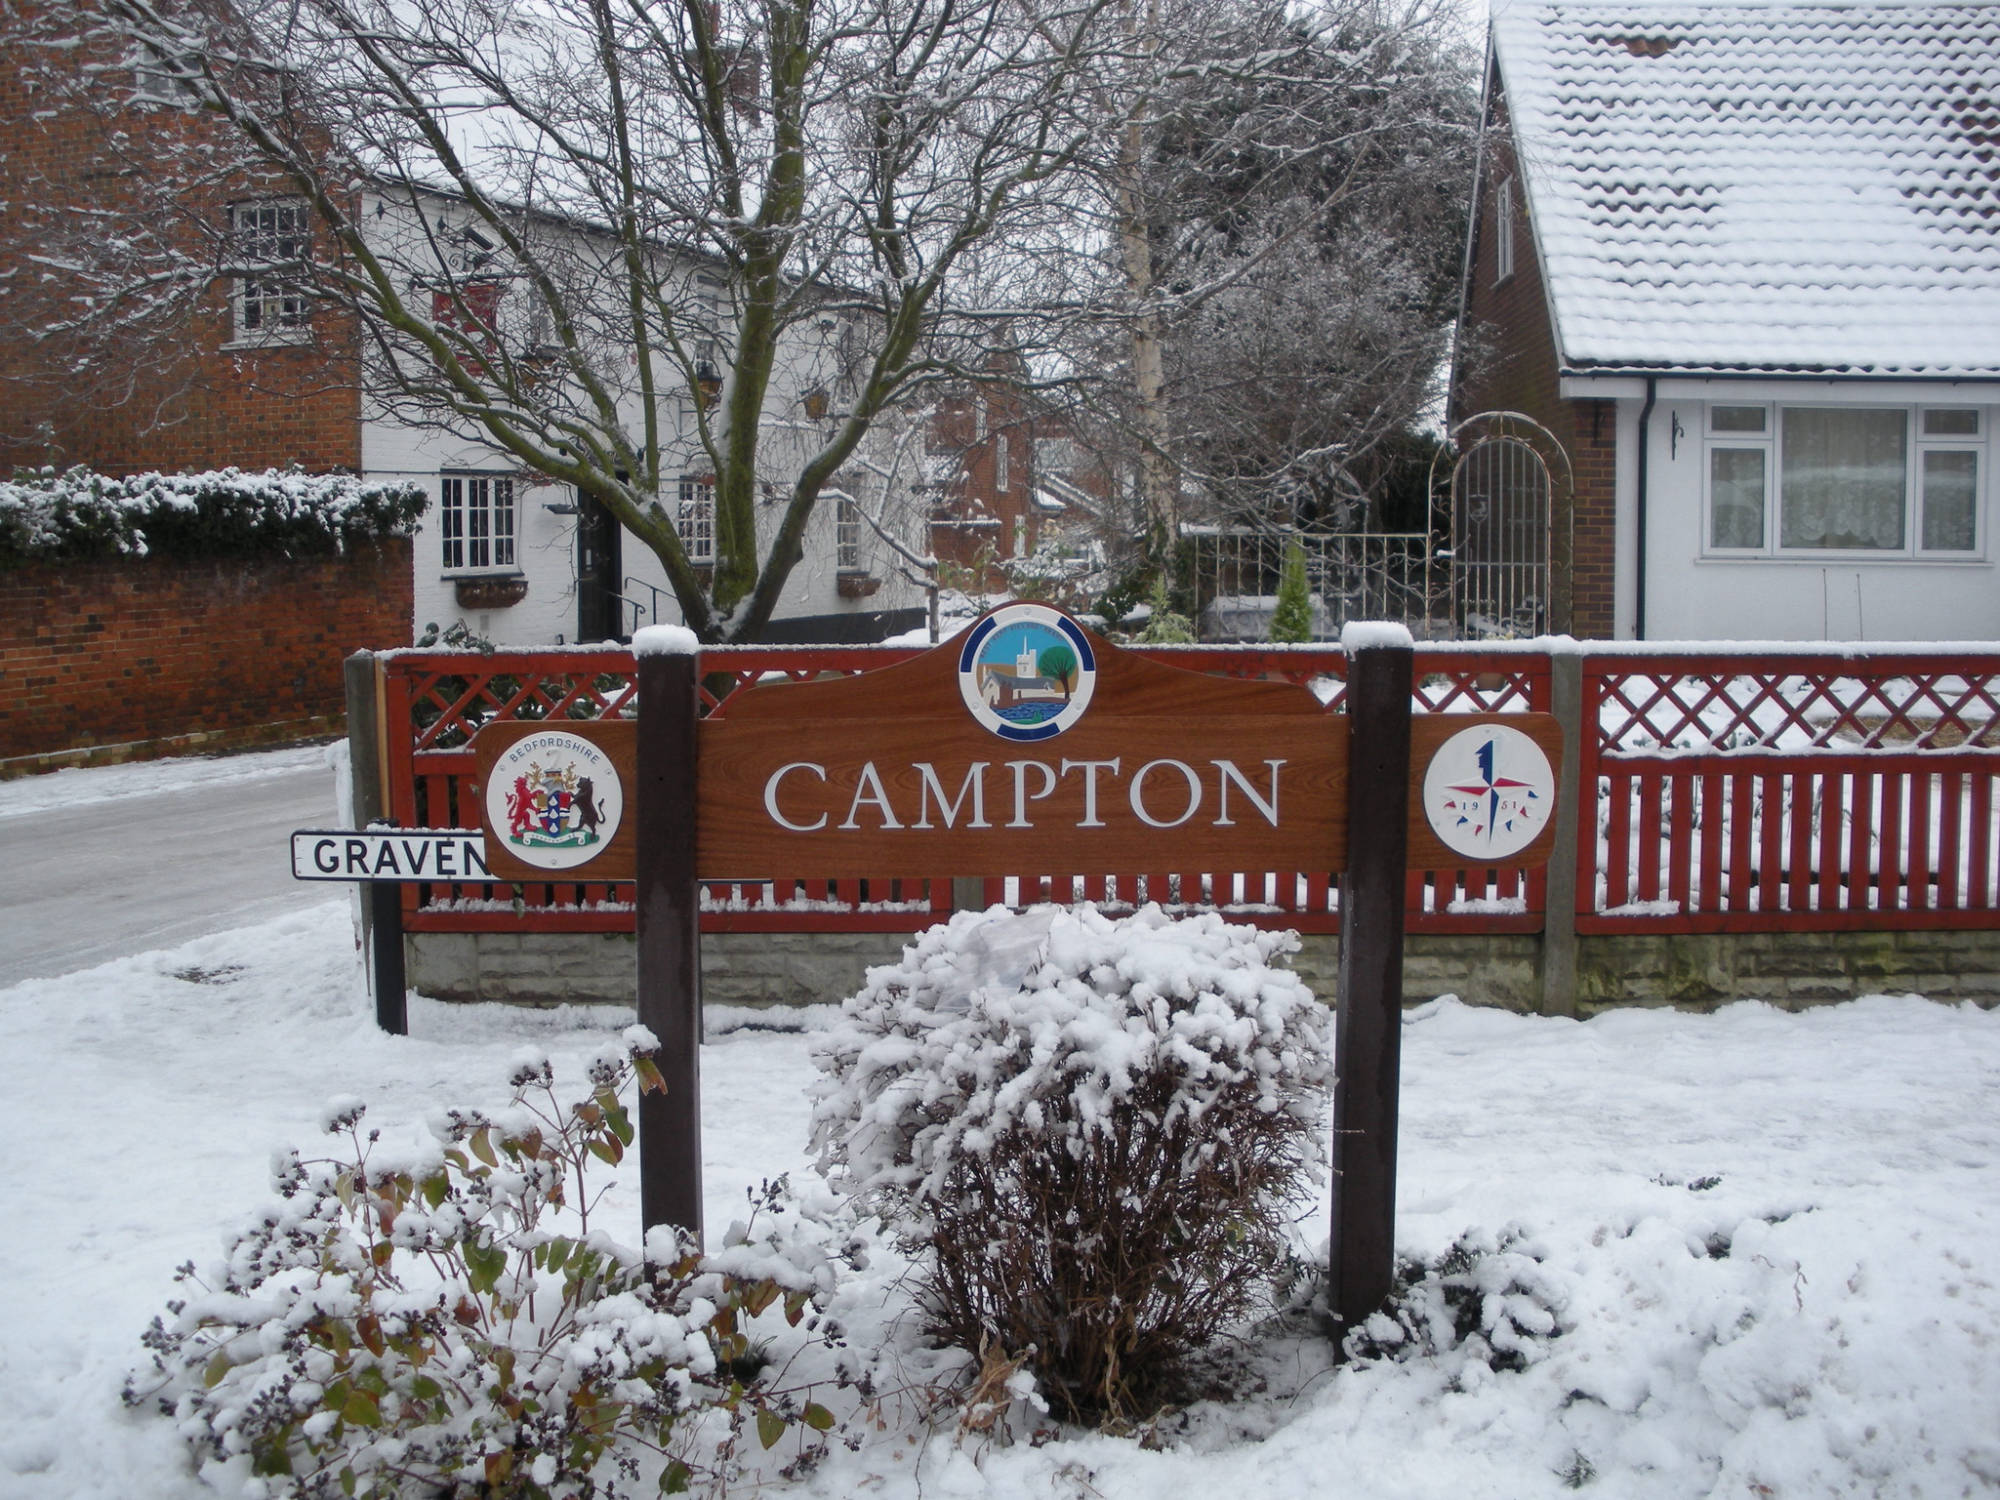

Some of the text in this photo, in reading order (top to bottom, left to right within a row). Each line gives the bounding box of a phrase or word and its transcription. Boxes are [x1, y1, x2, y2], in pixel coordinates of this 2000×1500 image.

[509, 738, 600, 764] BEDFORDSHIRE
[763, 756, 1288, 832] CAMPTON
[314, 839, 492, 876] GRAVEN
